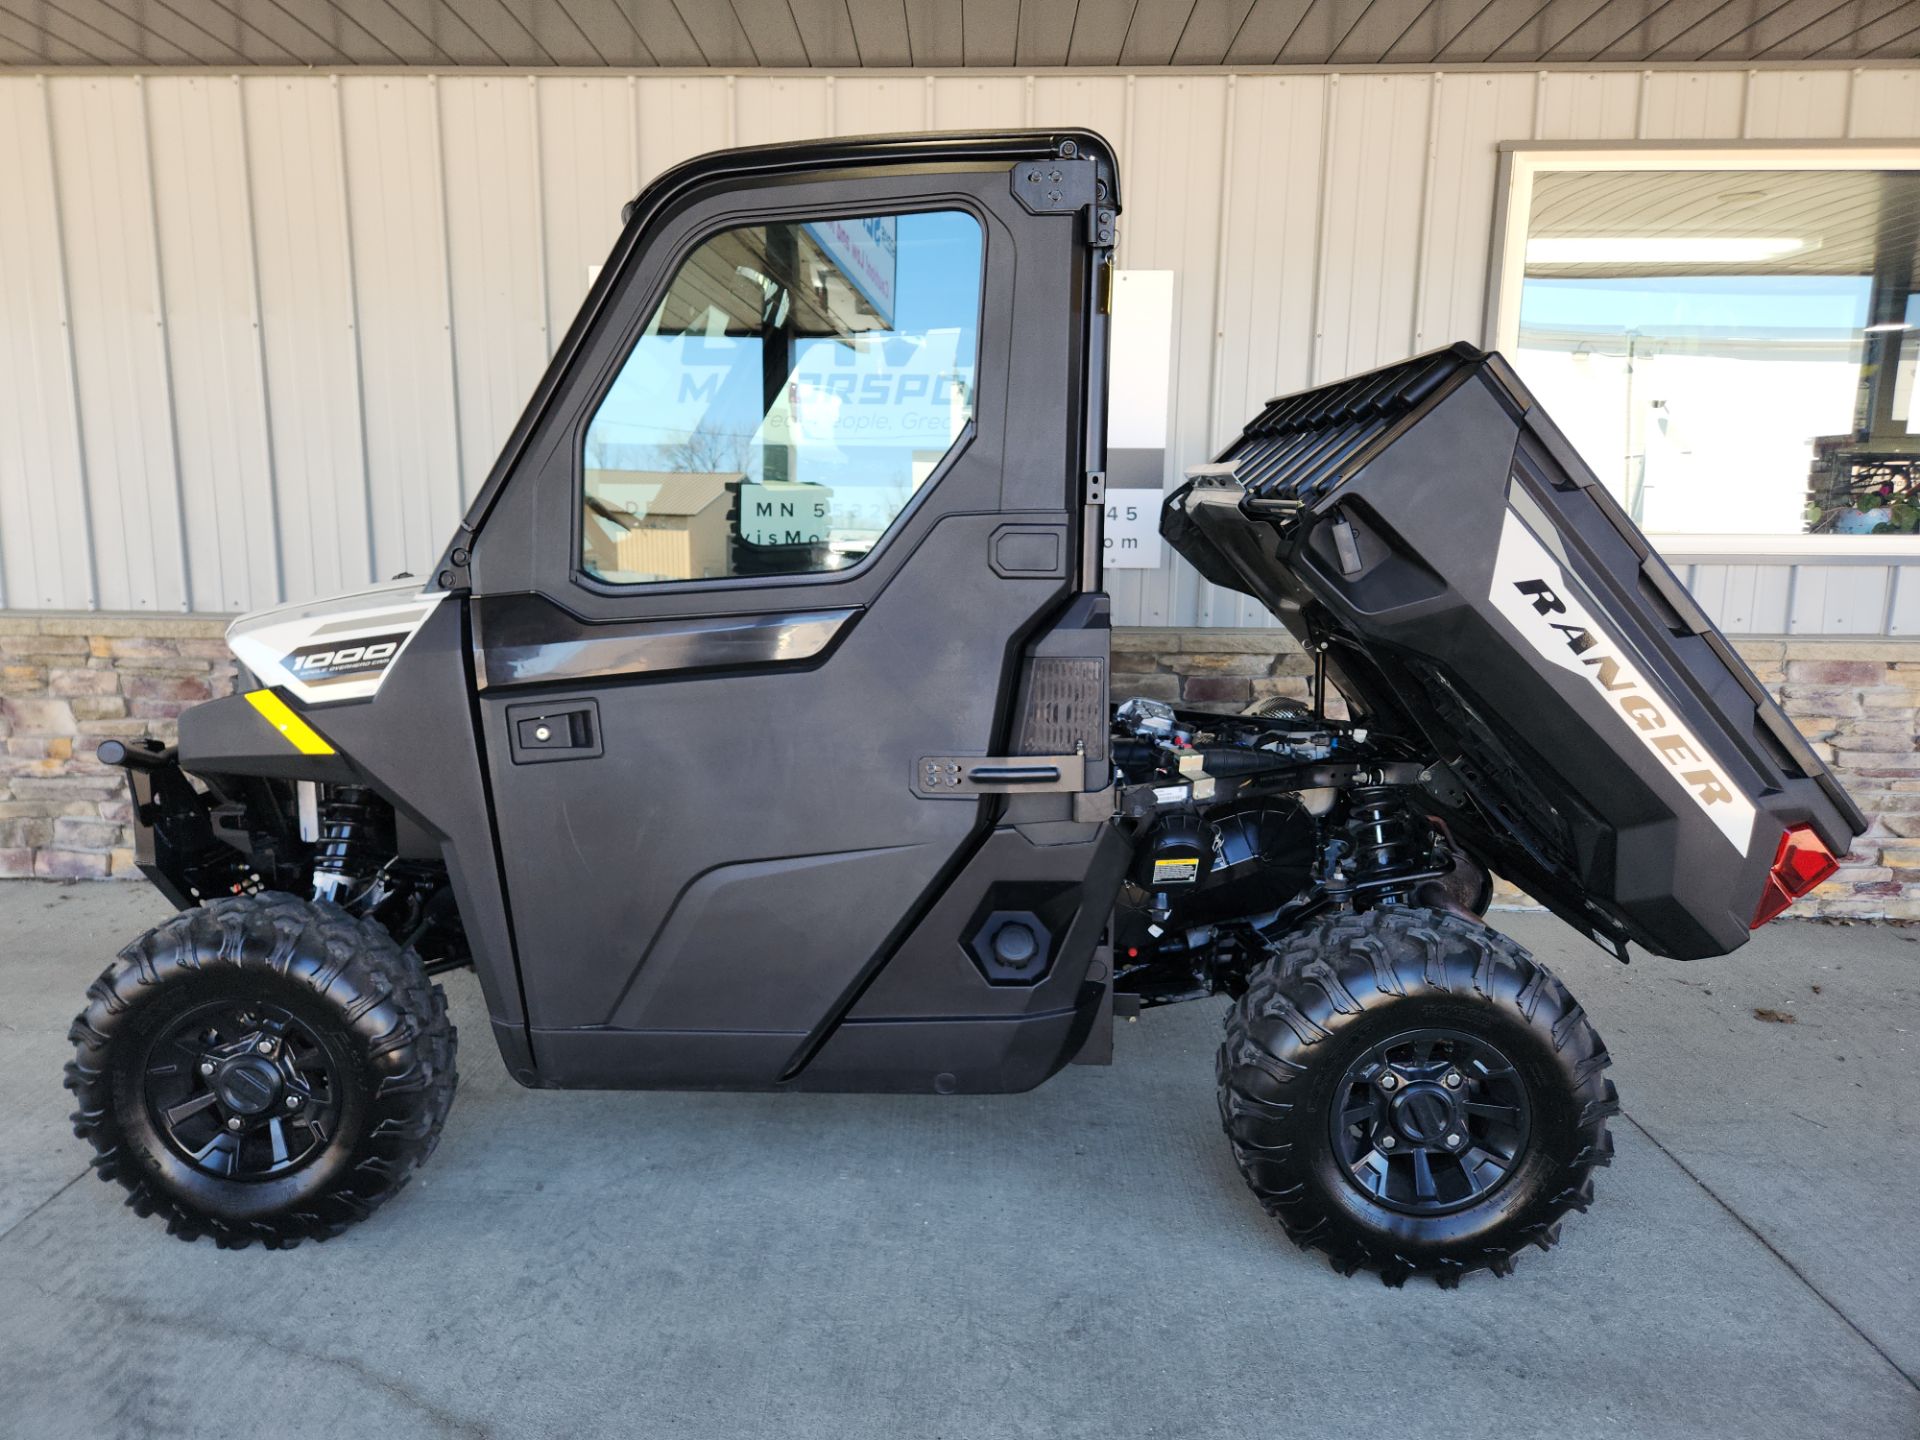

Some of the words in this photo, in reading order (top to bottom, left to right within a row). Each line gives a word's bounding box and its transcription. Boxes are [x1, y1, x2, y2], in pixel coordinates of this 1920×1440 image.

[756, 502, 794, 517] MN
[1106, 506, 1138, 521] 45
[292, 641, 398, 671] 1000
[1513, 578, 1733, 806] RANGER
